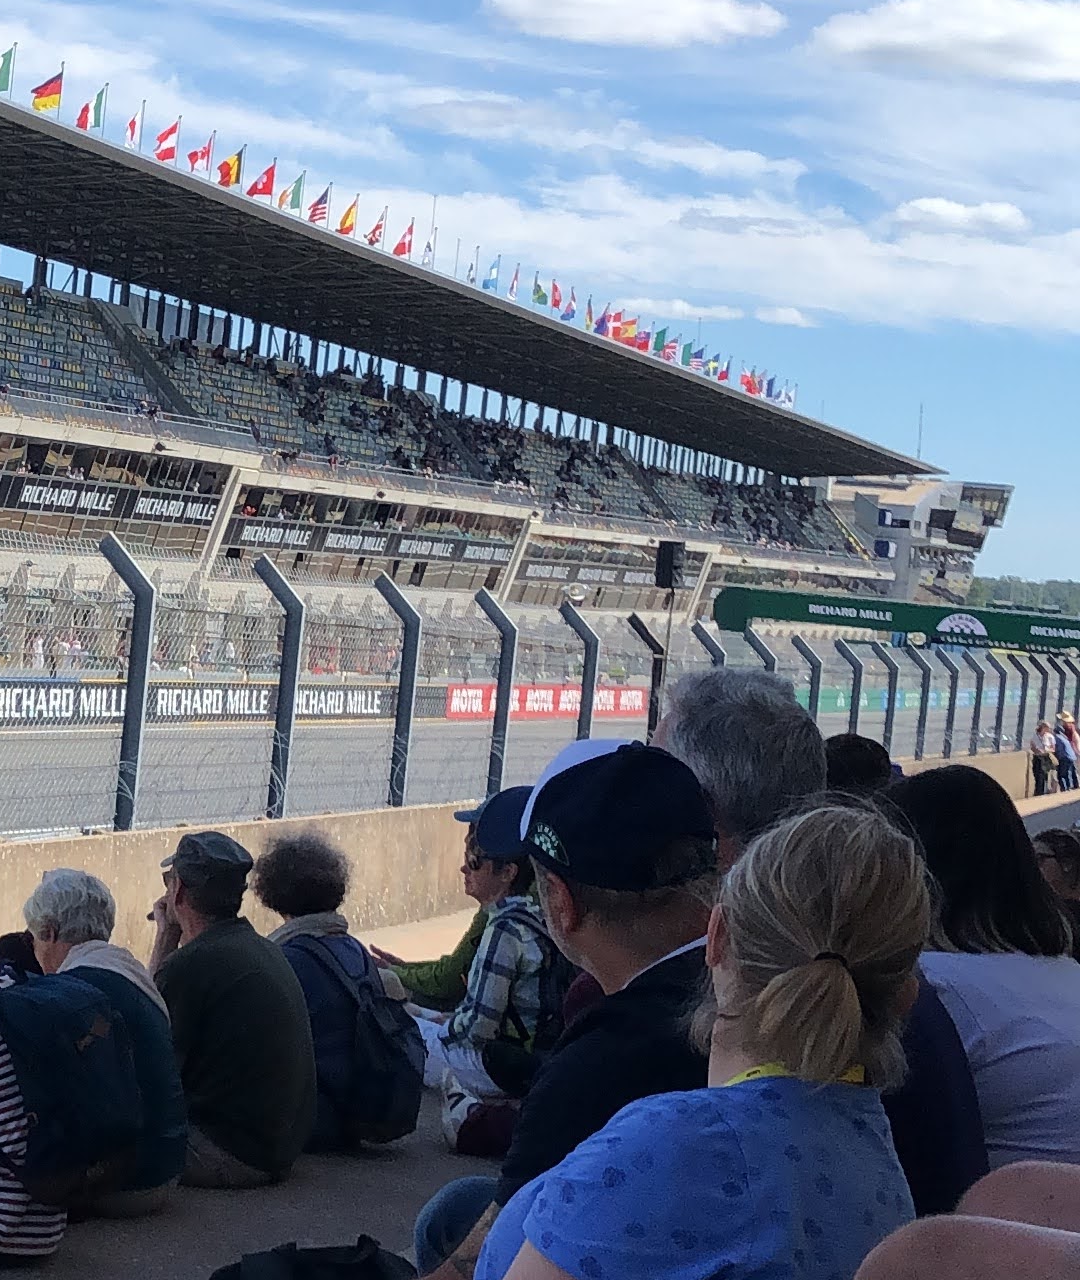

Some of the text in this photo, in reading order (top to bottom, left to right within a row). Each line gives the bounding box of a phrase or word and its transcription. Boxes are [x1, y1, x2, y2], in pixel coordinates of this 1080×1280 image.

[20, 484, 116, 511] RICHARD MILLE
[135, 497, 217, 520] RICHARD MILLE
[241, 525, 311, 546] RICHARD MILLE
[156, 688, 269, 716] RICHARD MILLE
[346, 690, 382, 714] MILLE
[450, 687, 483, 713] MOTUL
